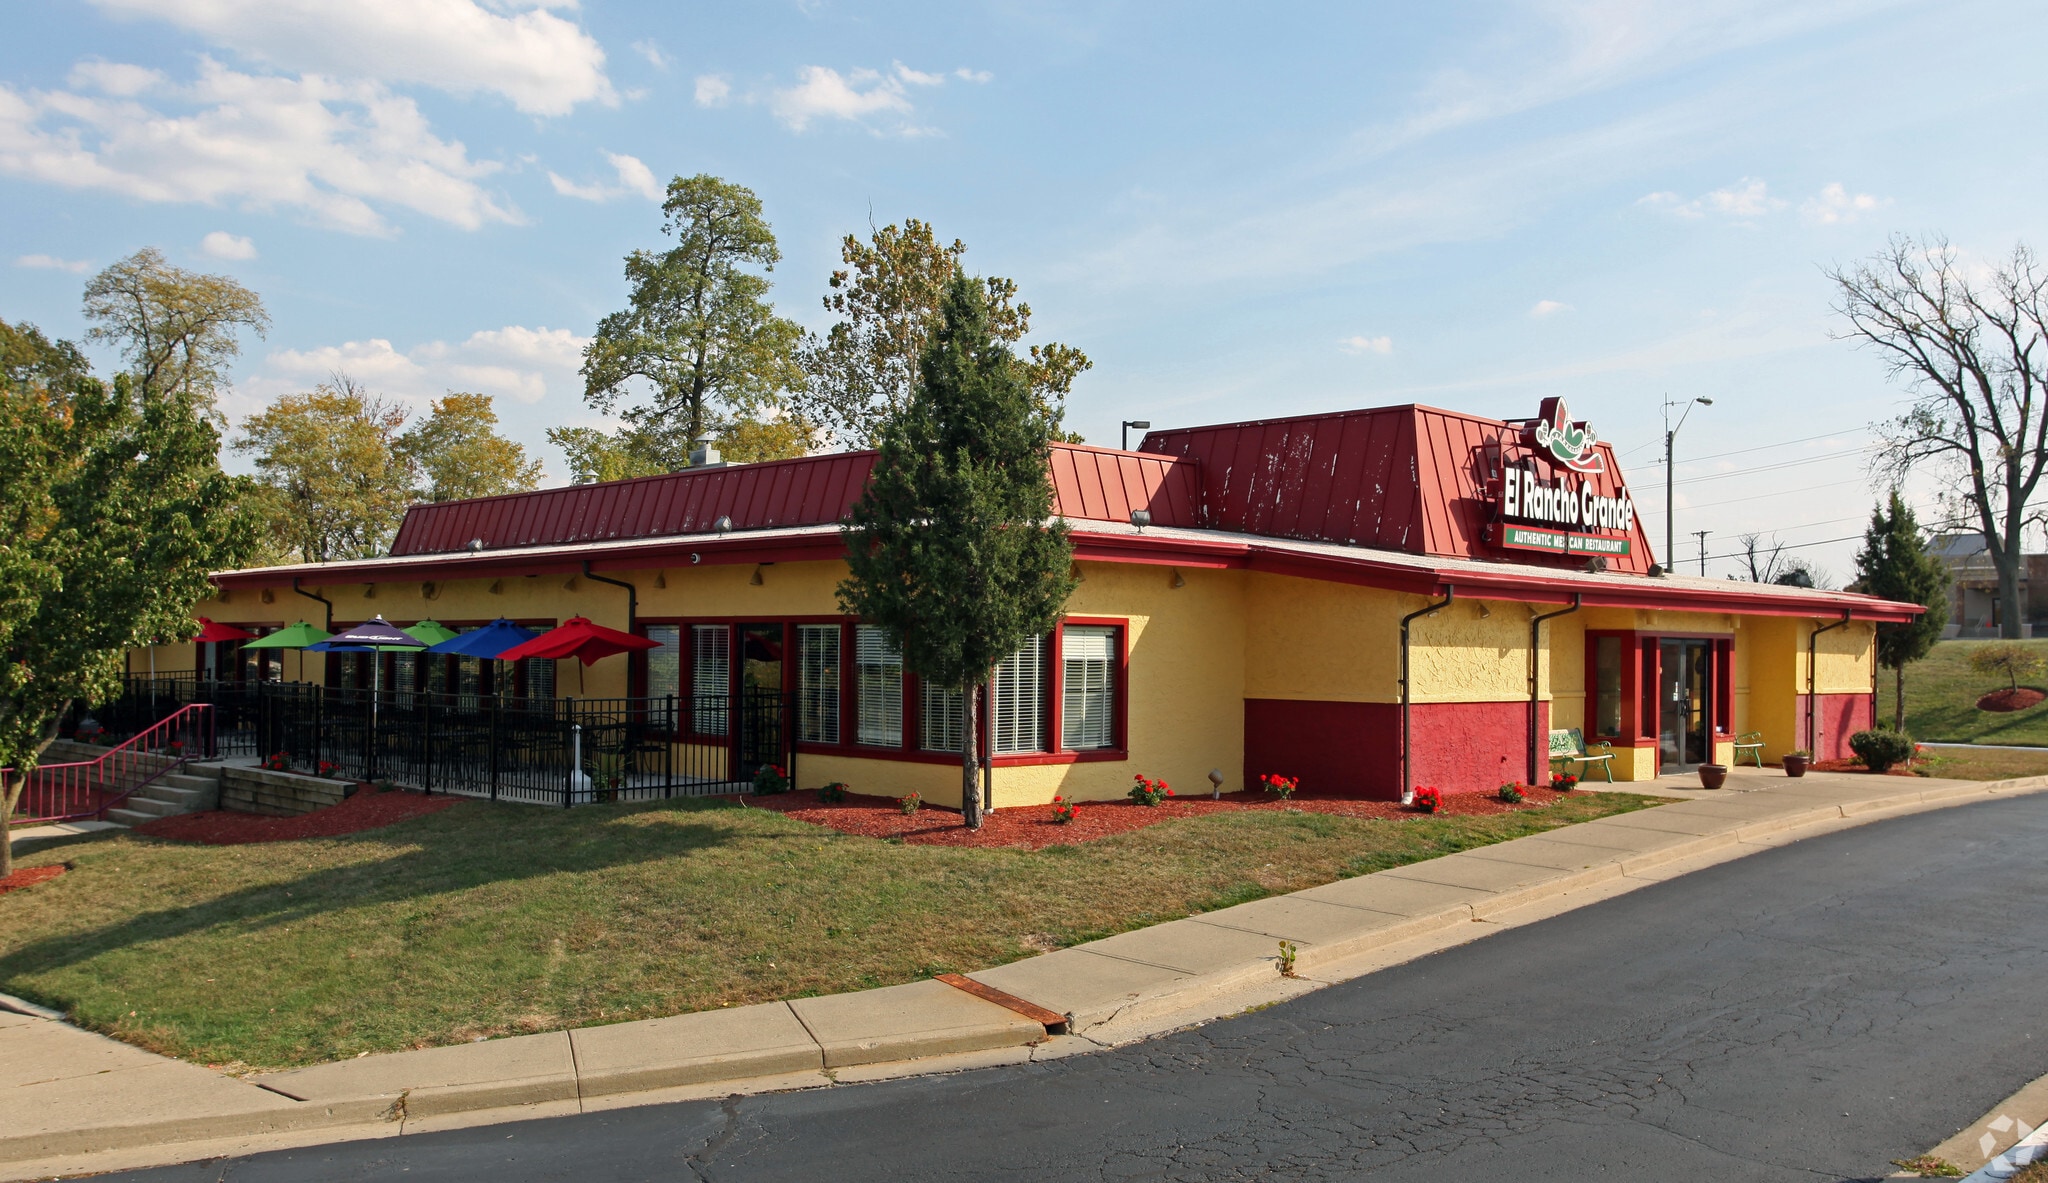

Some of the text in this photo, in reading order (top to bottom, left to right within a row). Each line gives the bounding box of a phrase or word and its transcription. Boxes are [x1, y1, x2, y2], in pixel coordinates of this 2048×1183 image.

[1505, 467, 1633, 531] El Rancho Grande
[1514, 530, 1552, 546] AUTHENTIC
[1585, 537, 1622, 553] RESTAURANT
